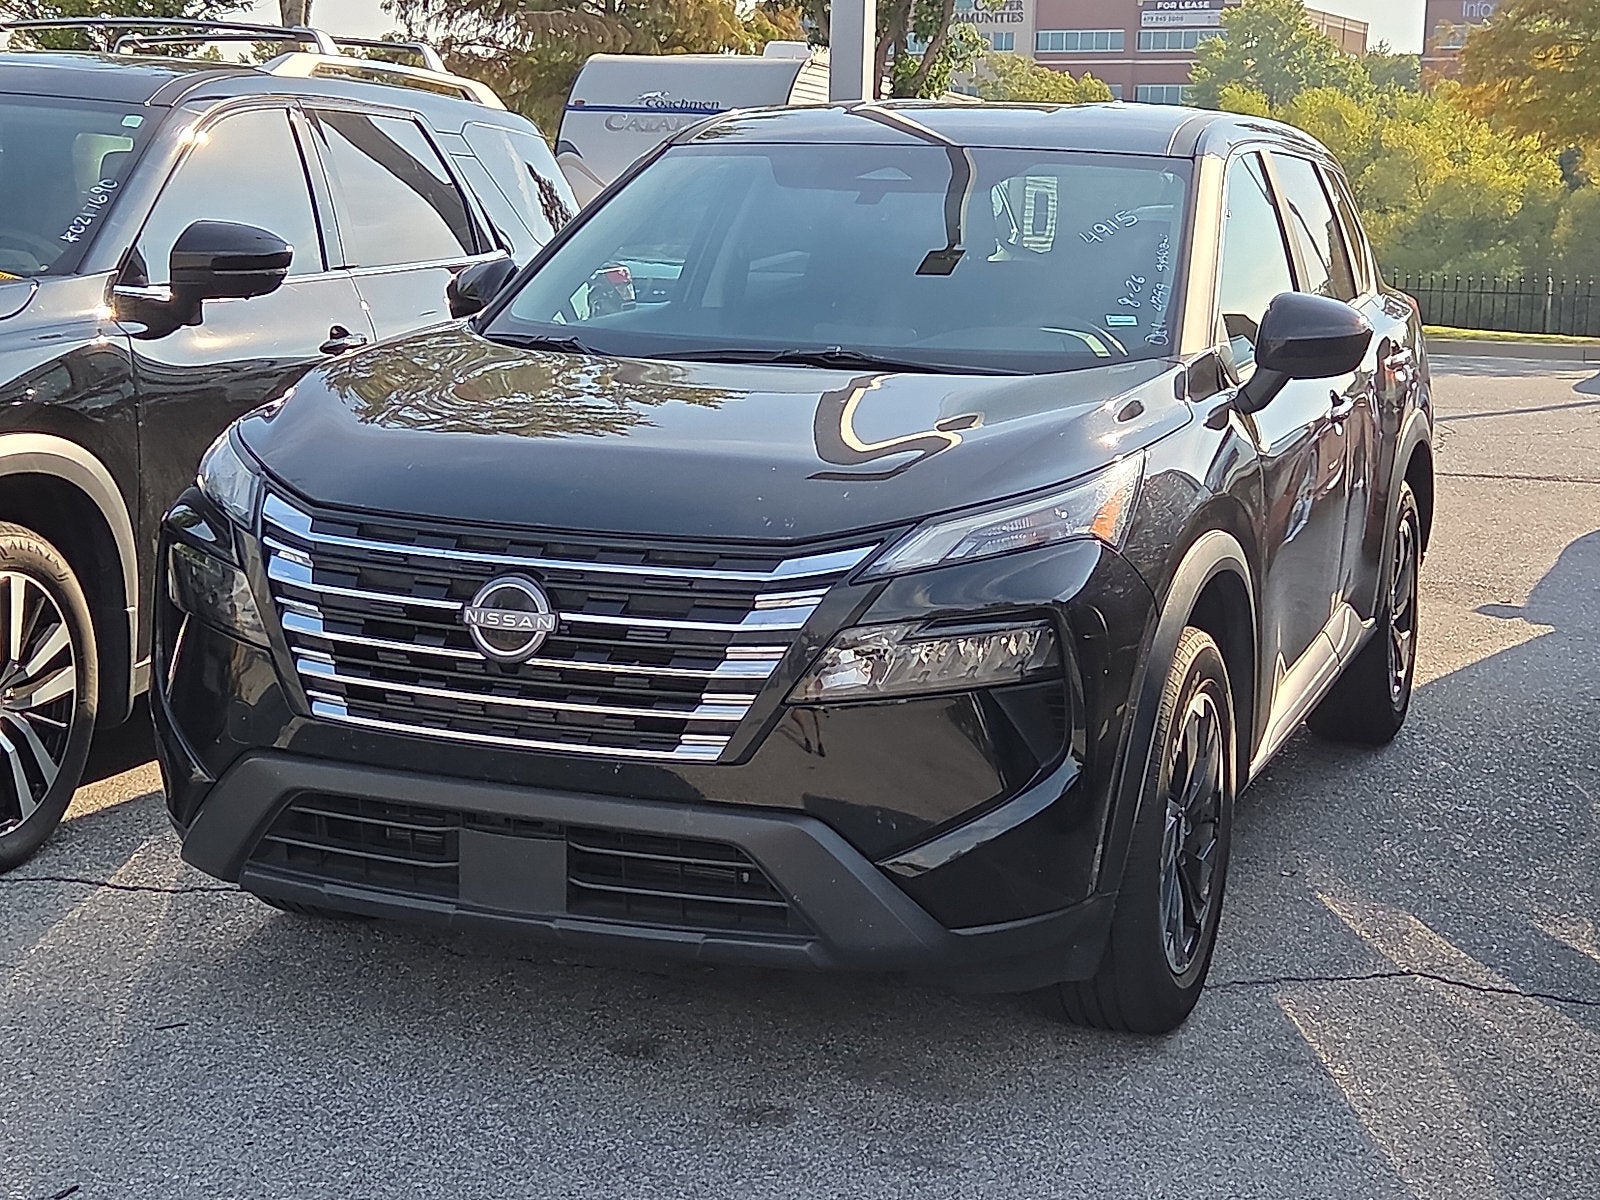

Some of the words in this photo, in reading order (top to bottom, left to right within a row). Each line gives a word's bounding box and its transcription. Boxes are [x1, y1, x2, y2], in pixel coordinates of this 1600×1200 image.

[974, 0, 1024, 11] CPER
[1157, 1, 1177, 9] FOR
[1179, 1, 1210, 9] LEASE
[1462, 1, 1495, 17] Info
[644, 99, 720, 110] Coachmen
[1079, 209, 1138, 244] 4915
[465, 609, 552, 629] NISSAN
